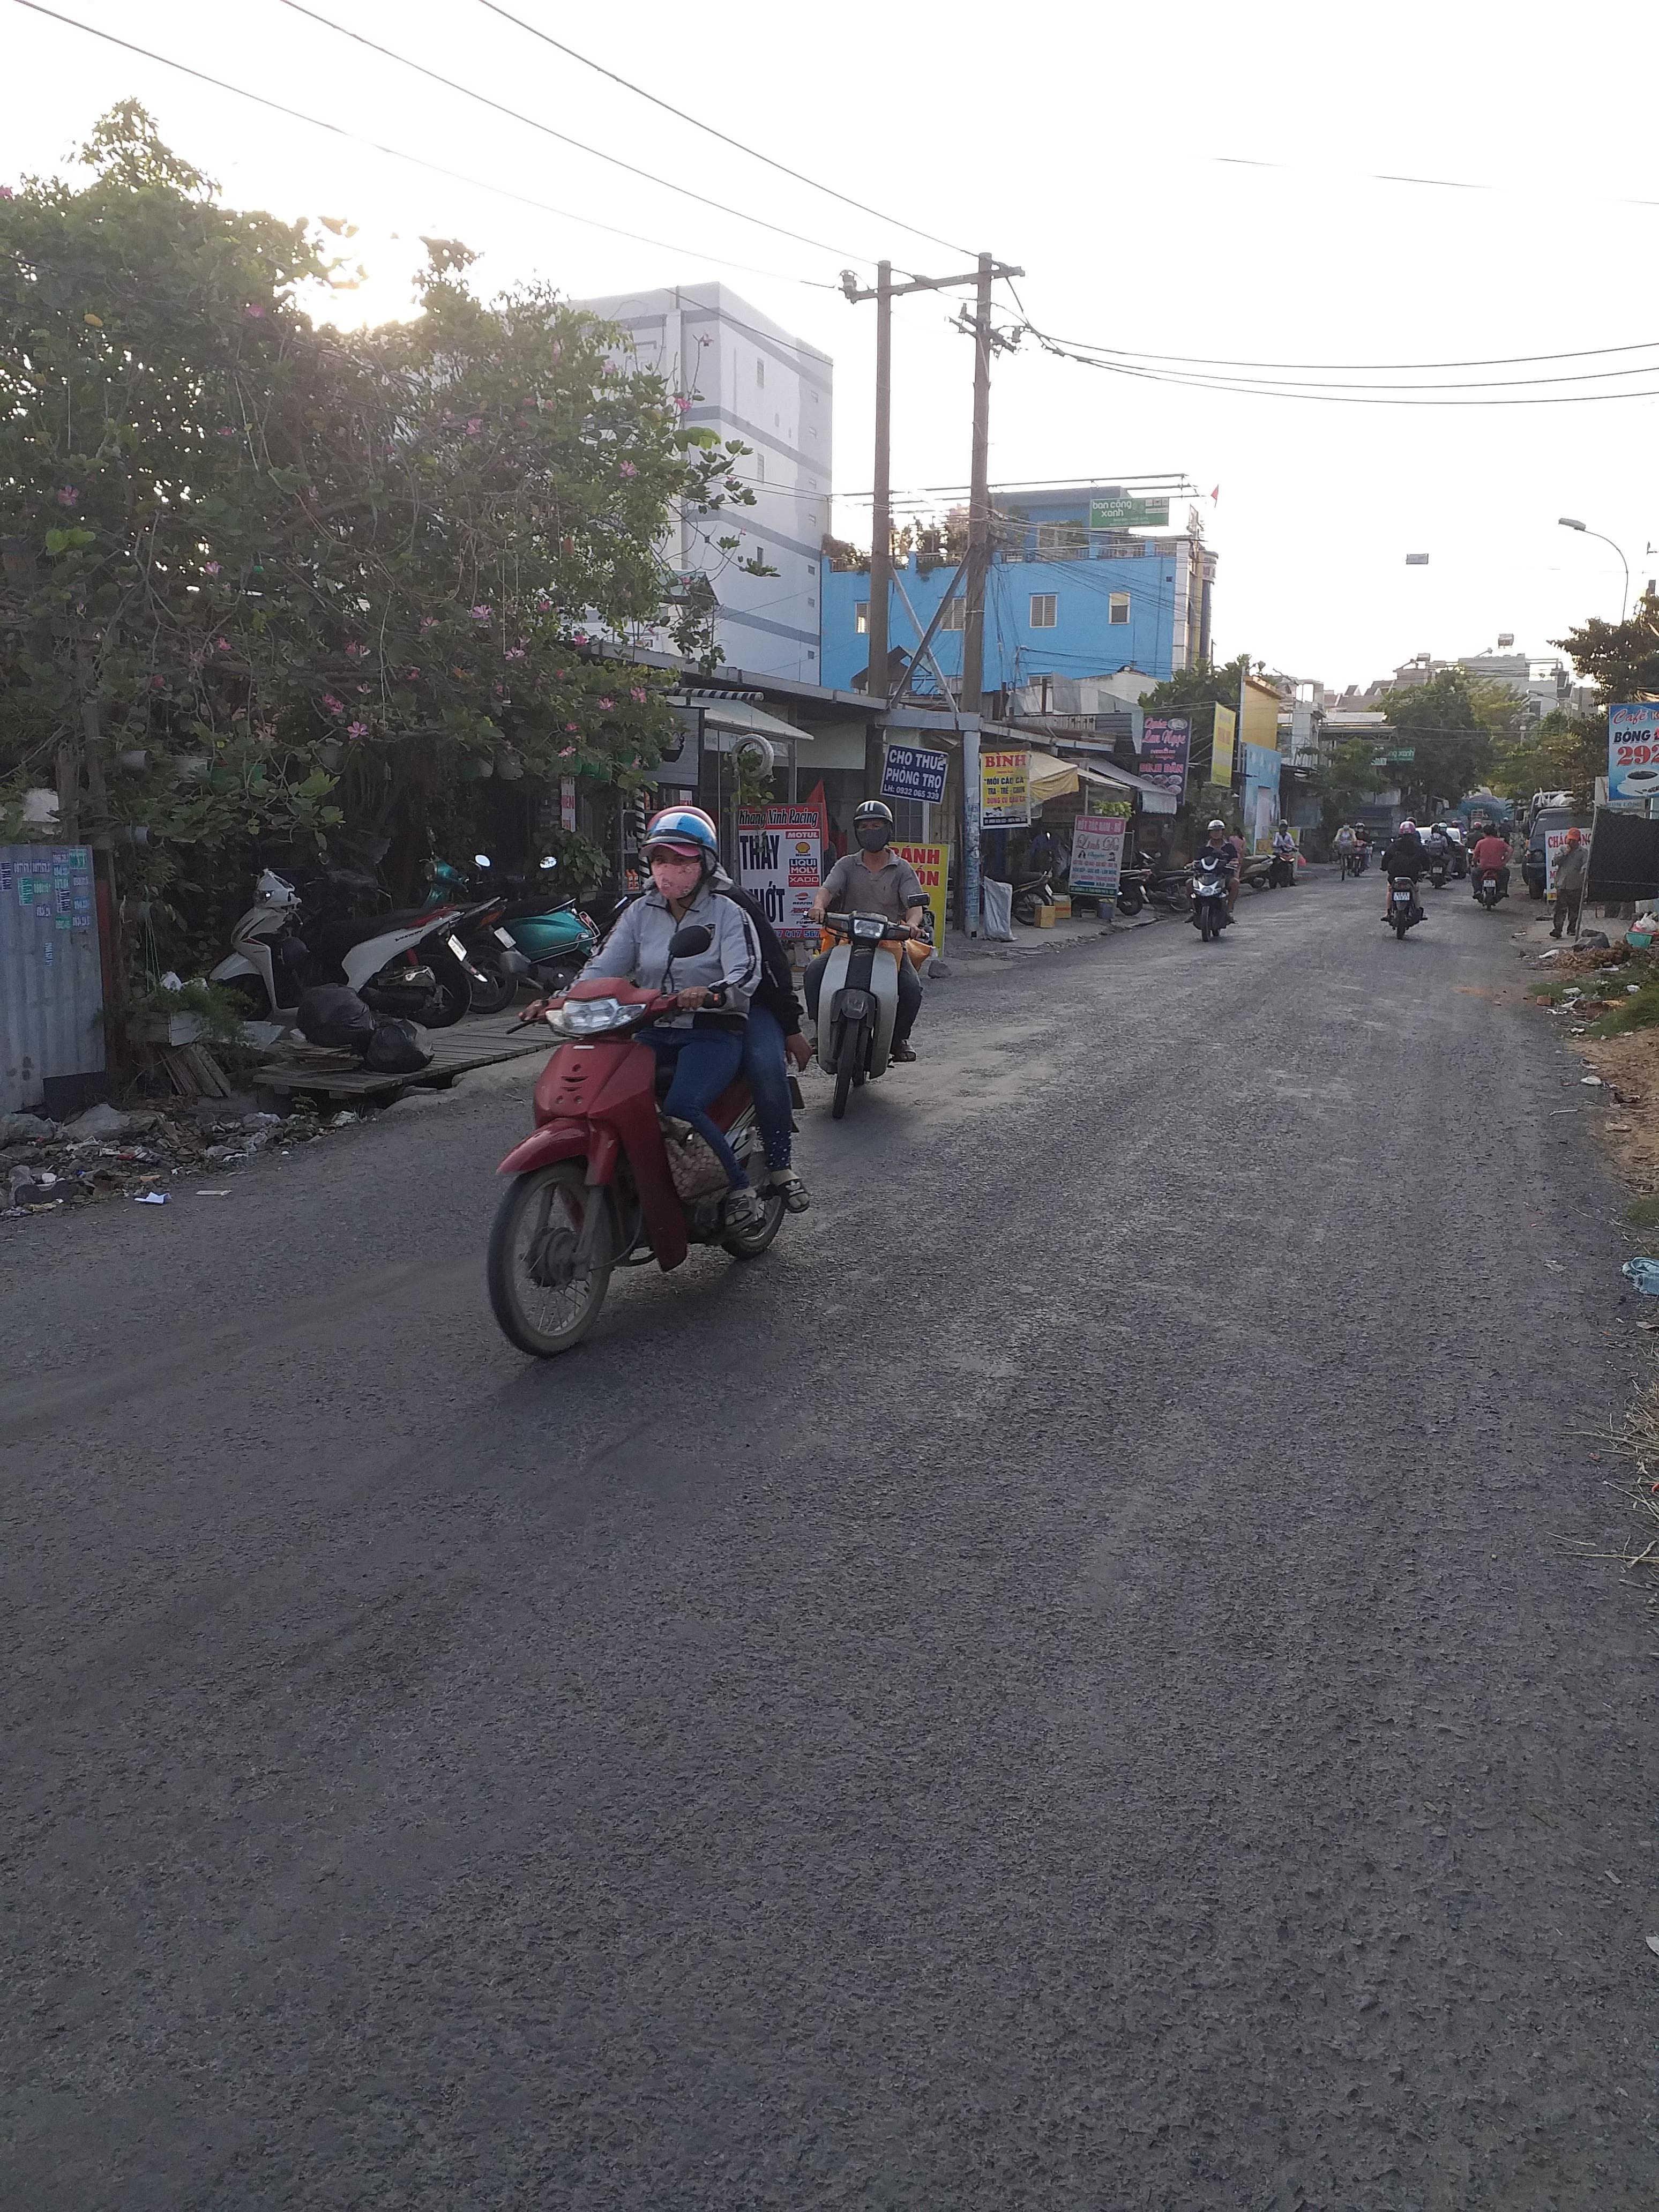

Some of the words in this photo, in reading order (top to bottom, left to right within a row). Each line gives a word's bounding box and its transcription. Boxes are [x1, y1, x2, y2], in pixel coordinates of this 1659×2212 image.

[1093, 501, 1108, 509] ban
[1101, 509, 1124, 517] xanh
[1613, 727, 1651, 743] BÓNG
[889, 749, 913, 765] CHO
[915, 753, 945, 771] THUÊ
[985, 753, 1026, 767] BÌNH
[885, 766, 920, 786] PHÒNG
[922, 773, 942, 793] TRỌ
[884, 784, 895, 793] LH:
[896, 786, 912, 795] 0932
[913, 789, 926, 798] 065
[926, 791, 939, 800] 339
[738, 809, 766, 829] Khang
[767, 809, 787, 825] Ninh
[788, 808, 819, 828] Racing
[739, 835, 780, 870] THAY
[791, 866, 817, 874] MOLY
[749, 881, 784, 923] HỚT
[394, 929, 423, 941] VISION
[785, 930, 801, 938] 417
[804, 930, 820, 938] 567
